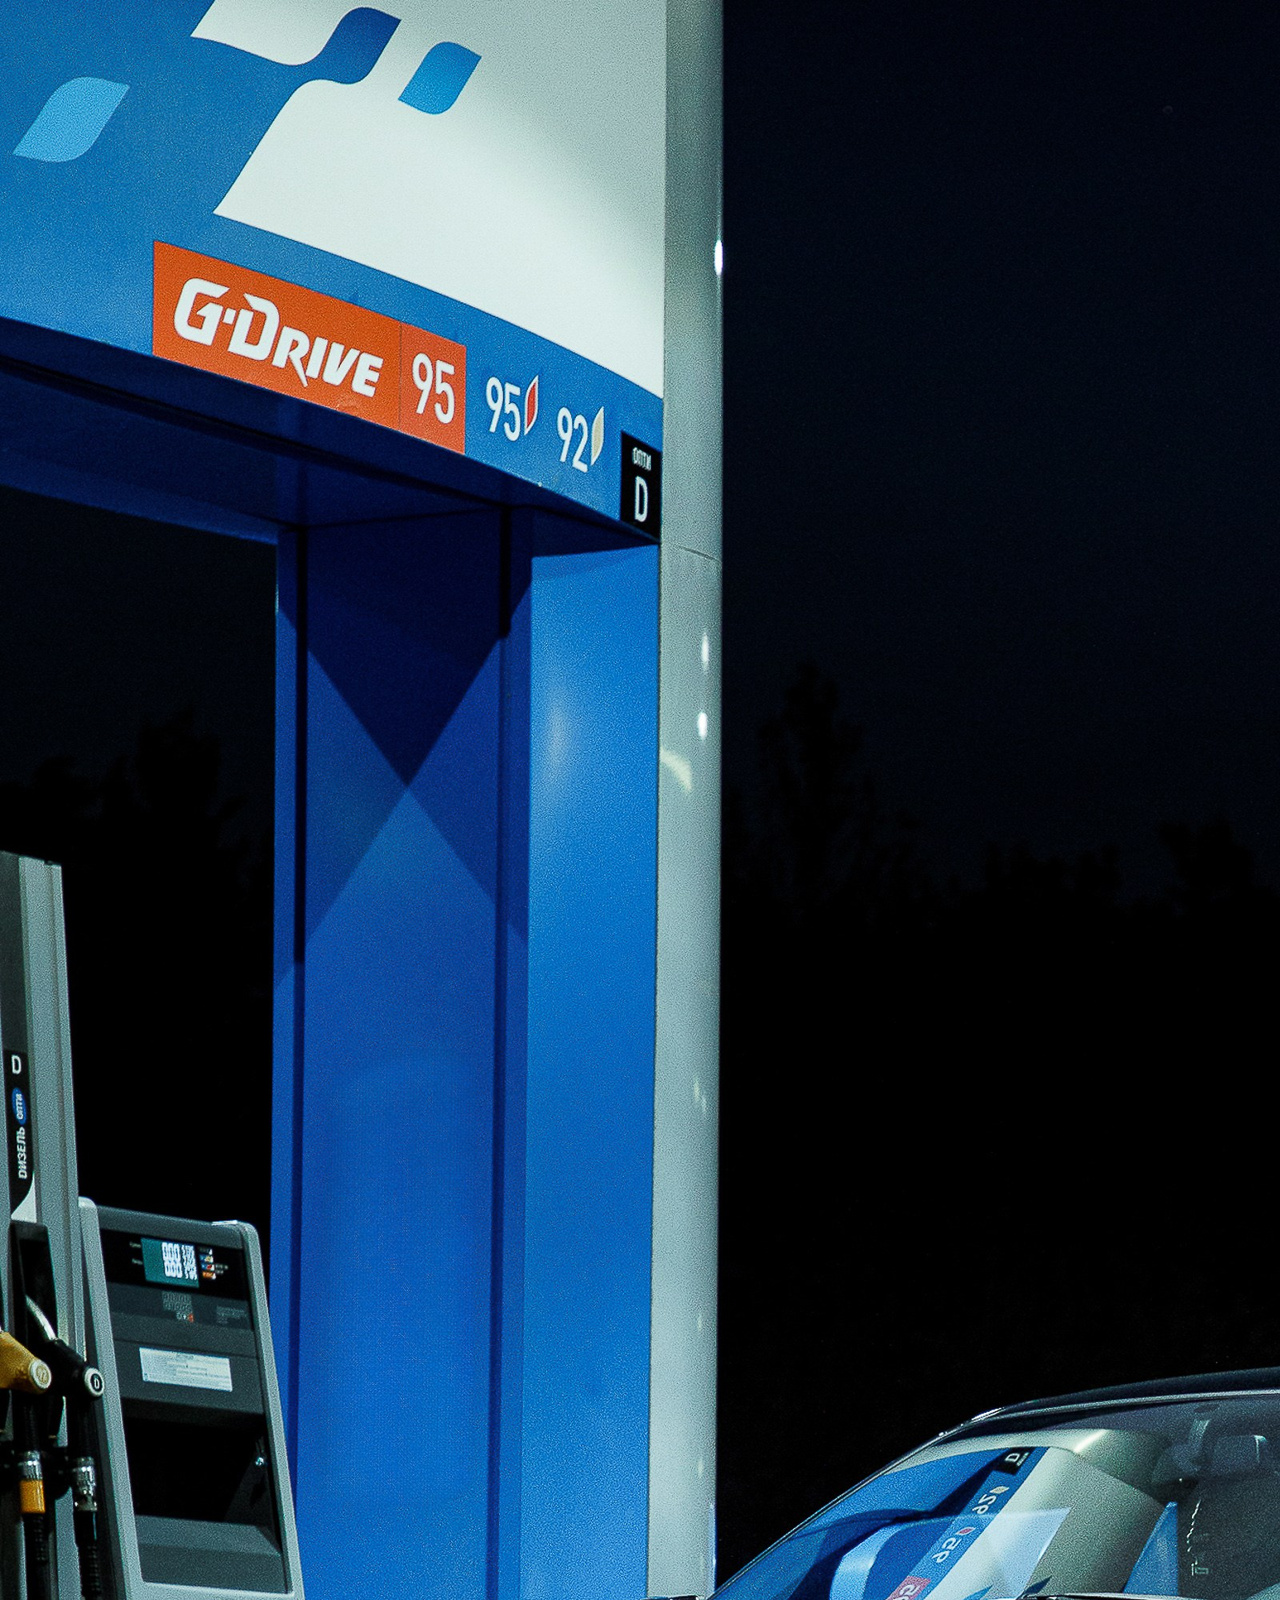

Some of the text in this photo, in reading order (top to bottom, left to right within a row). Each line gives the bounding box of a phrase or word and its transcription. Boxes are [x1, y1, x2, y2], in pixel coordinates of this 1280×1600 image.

[412, 352, 455, 424] 95
[486, 376, 588, 473] 95 92
[634, 475, 648, 522] D
[11, 1054, 21, 1075] D
